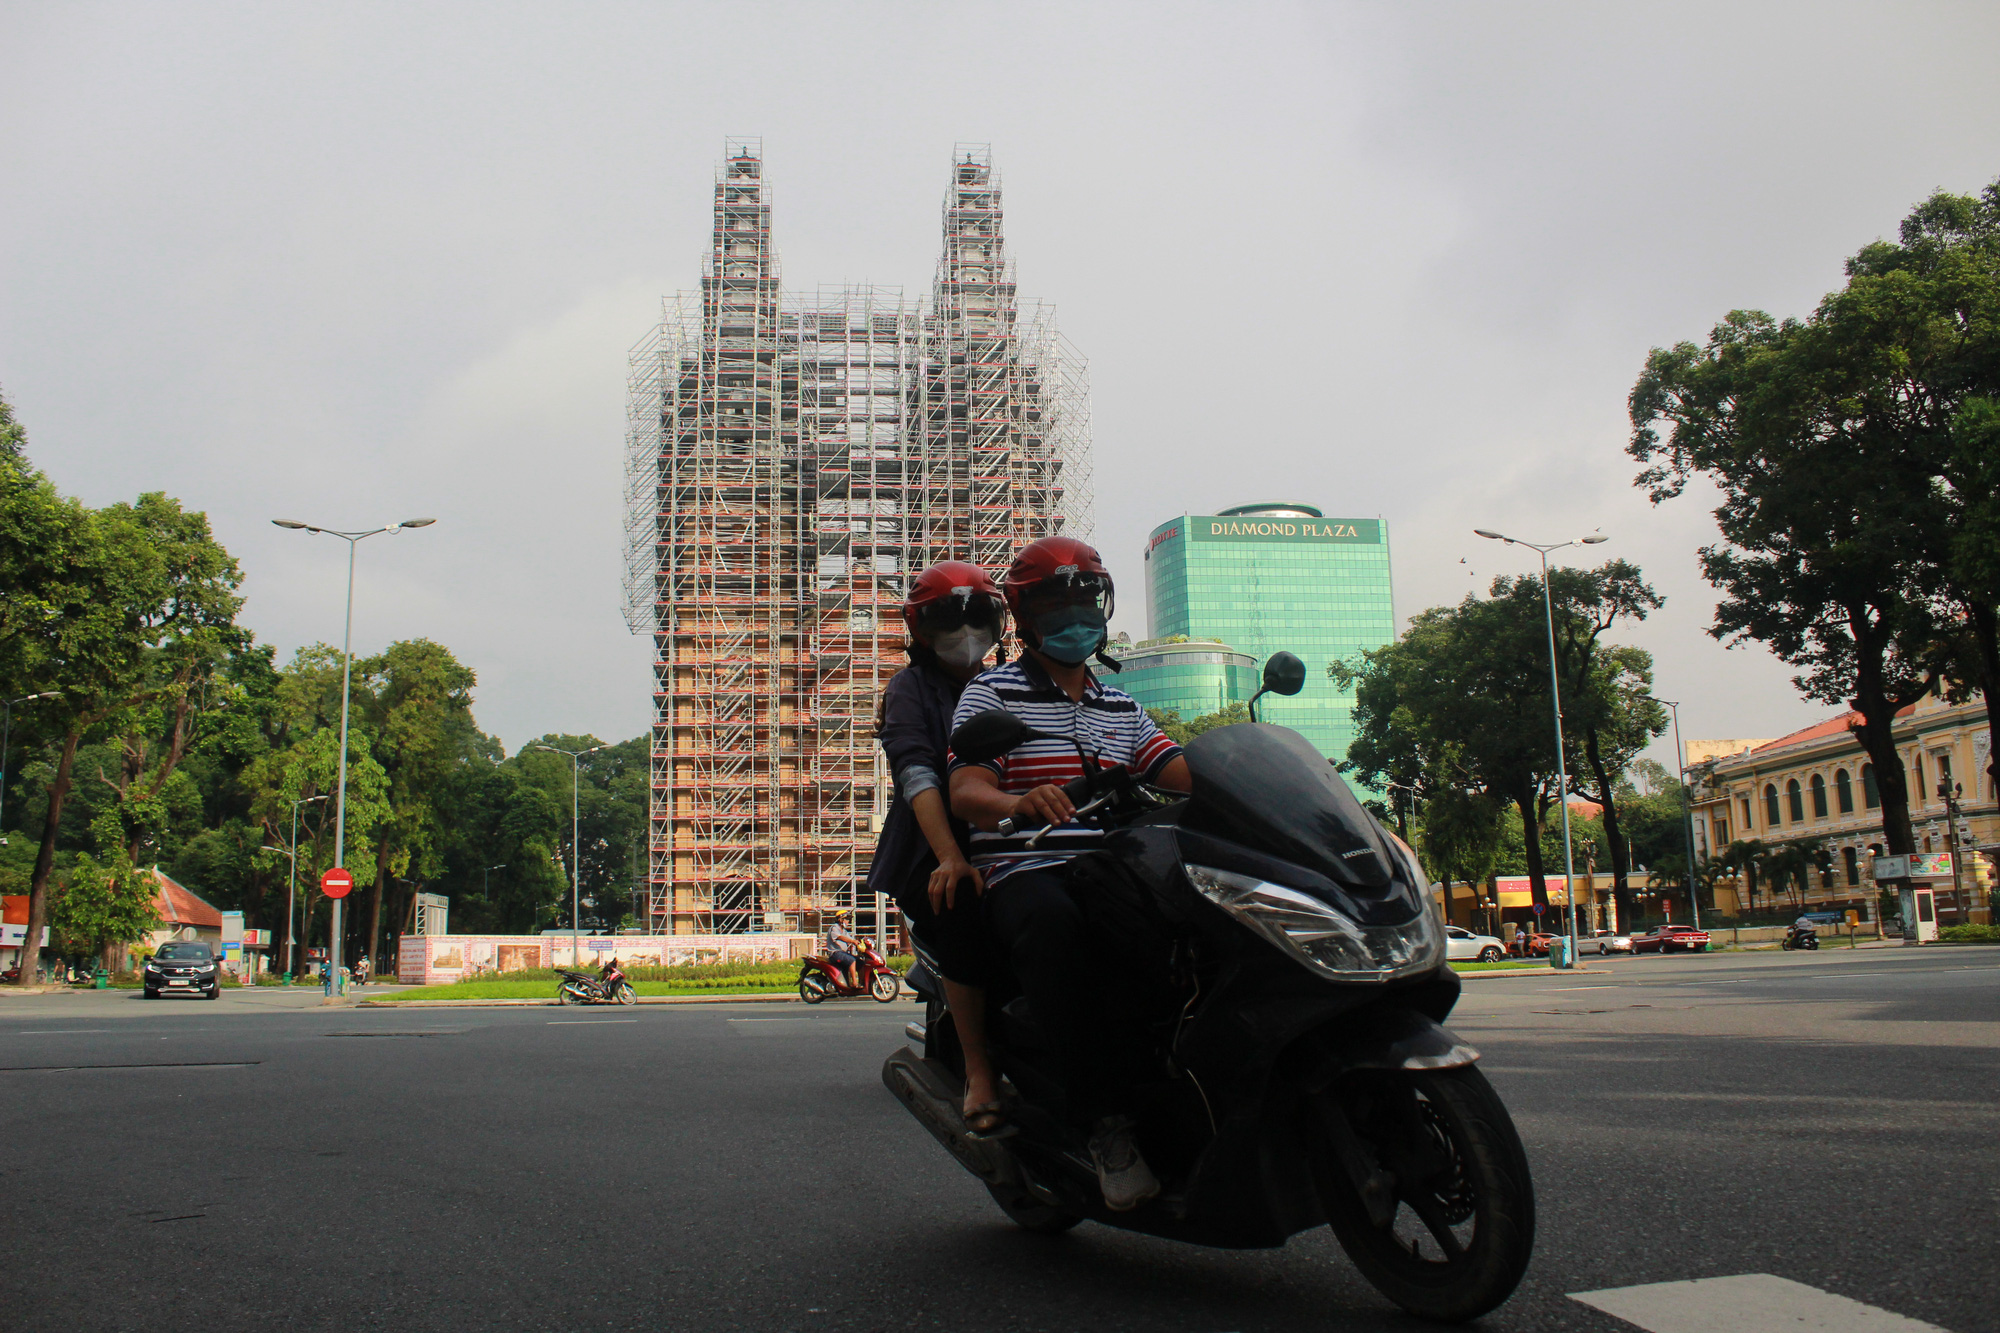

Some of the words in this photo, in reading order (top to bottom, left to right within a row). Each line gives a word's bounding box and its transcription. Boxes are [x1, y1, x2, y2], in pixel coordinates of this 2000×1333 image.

[1154, 526, 1178, 546] LOTTE
[1211, 522, 1296, 536] DIAMOND
[1302, 524, 1358, 537] PLAZA
[1341, 847, 1377, 859] HONDA
